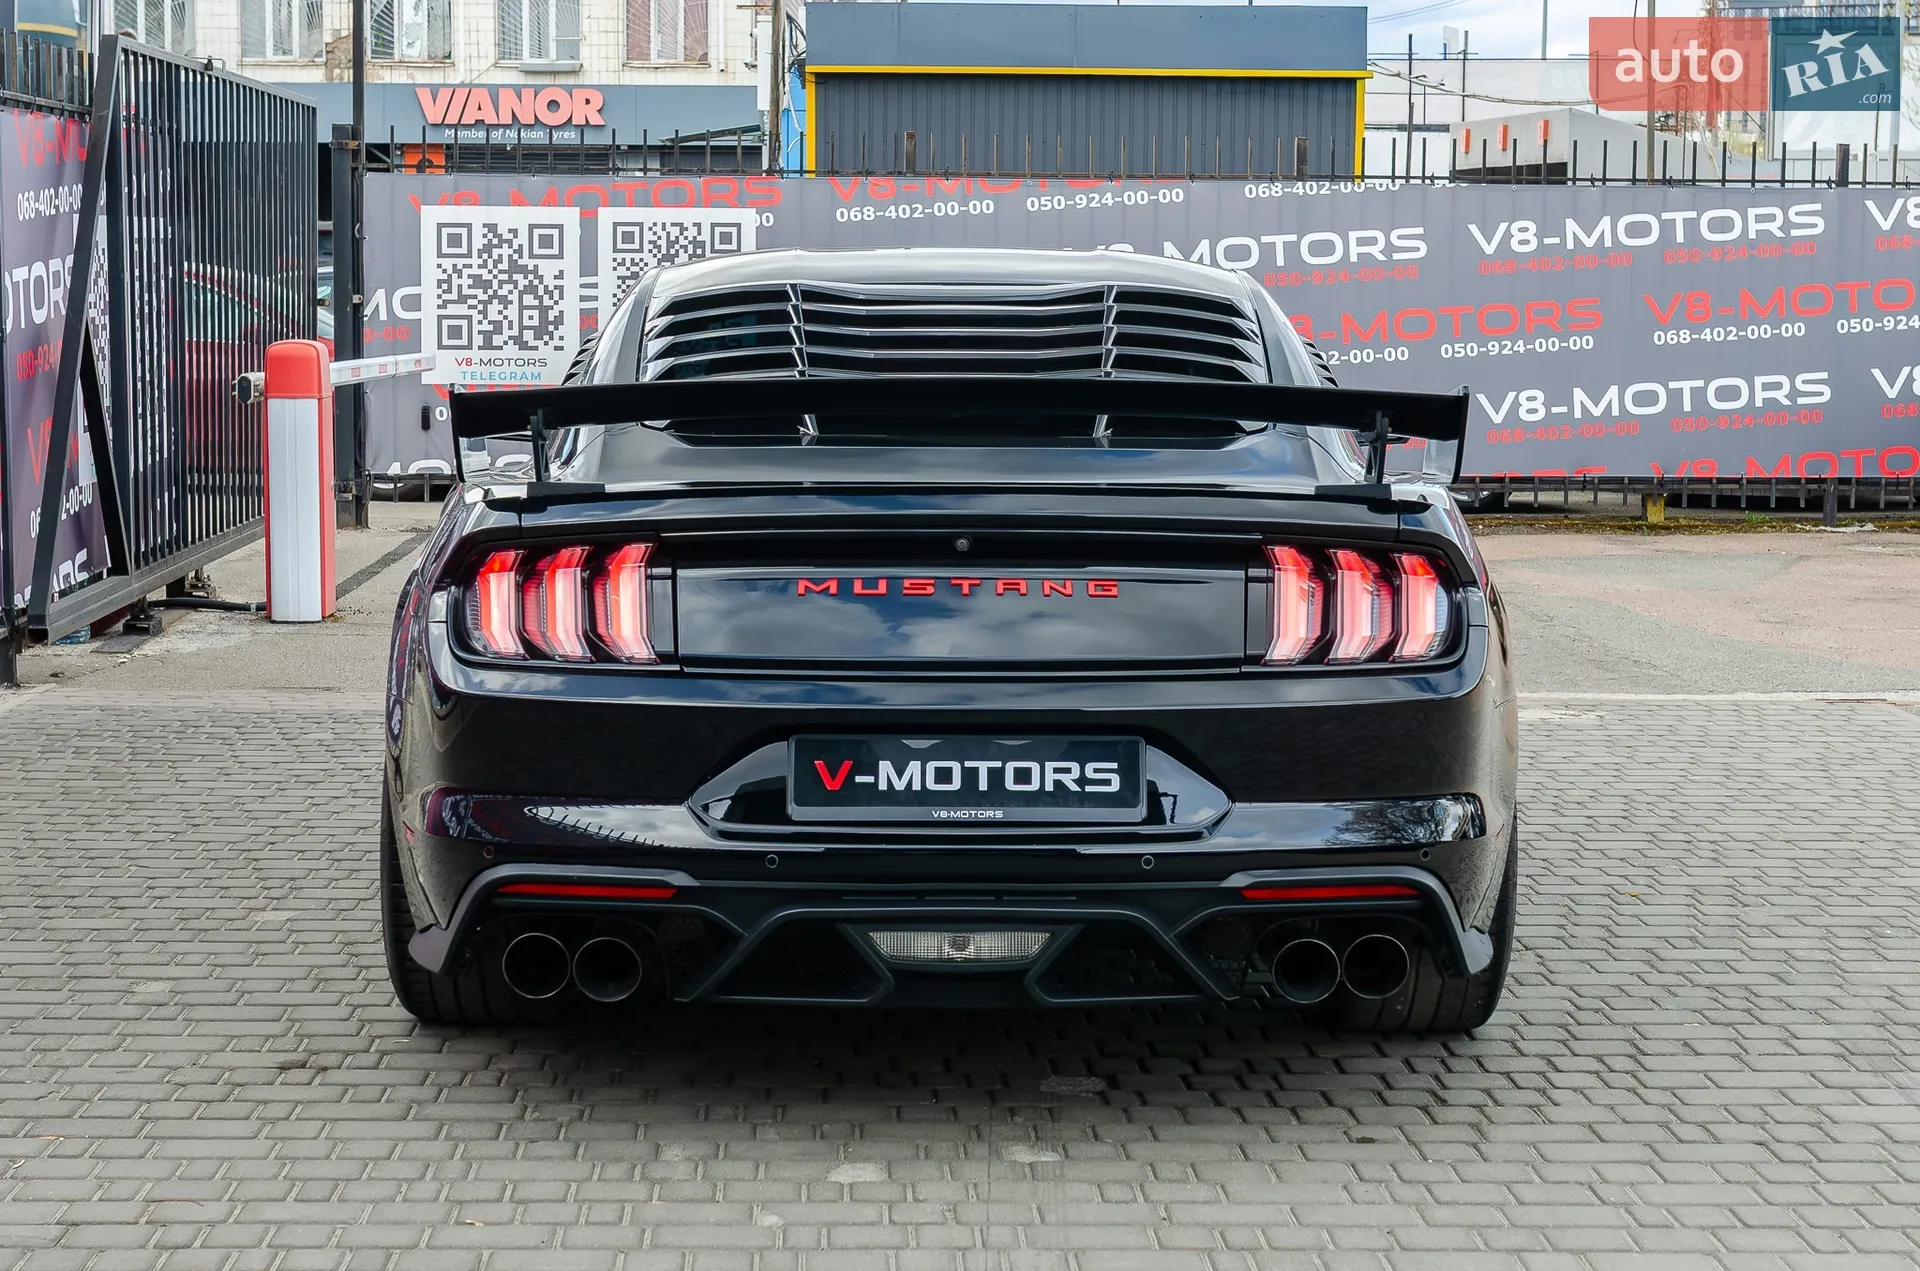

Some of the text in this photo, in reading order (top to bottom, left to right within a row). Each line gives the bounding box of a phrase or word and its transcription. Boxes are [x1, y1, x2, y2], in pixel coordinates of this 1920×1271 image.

[415, 86, 606, 126] VIANOR
[836, 188, 1185, 223] 068-402-00-00 050-924-00-00
[1467, 203, 1825, 255] V8-MOTORS
[1478, 241, 1817, 275] 068-402-00-00 050-924-00-00
[1264, 265, 1419, 287] 050-924-00-00
[1288, 298, 1603, 344] 8-MOTORS
[1653, 322, 1806, 345] 068-402-00-00
[455, 358, 547, 367] V8-MOTORS
[1440, 336, 1594, 358] 050-924-00-00
[461, 371, 541, 381] TELEGRAM
[1476, 371, 1832, 424] V8-MOTORS
[1487, 409, 1823, 444] 068-402-00-00 050-924-00-00
[796, 578, 1119, 598] MUSTANG
[814, 760, 1120, 792] V-MOTORS
[931, 810, 1004, 818] V8-MOTORS
